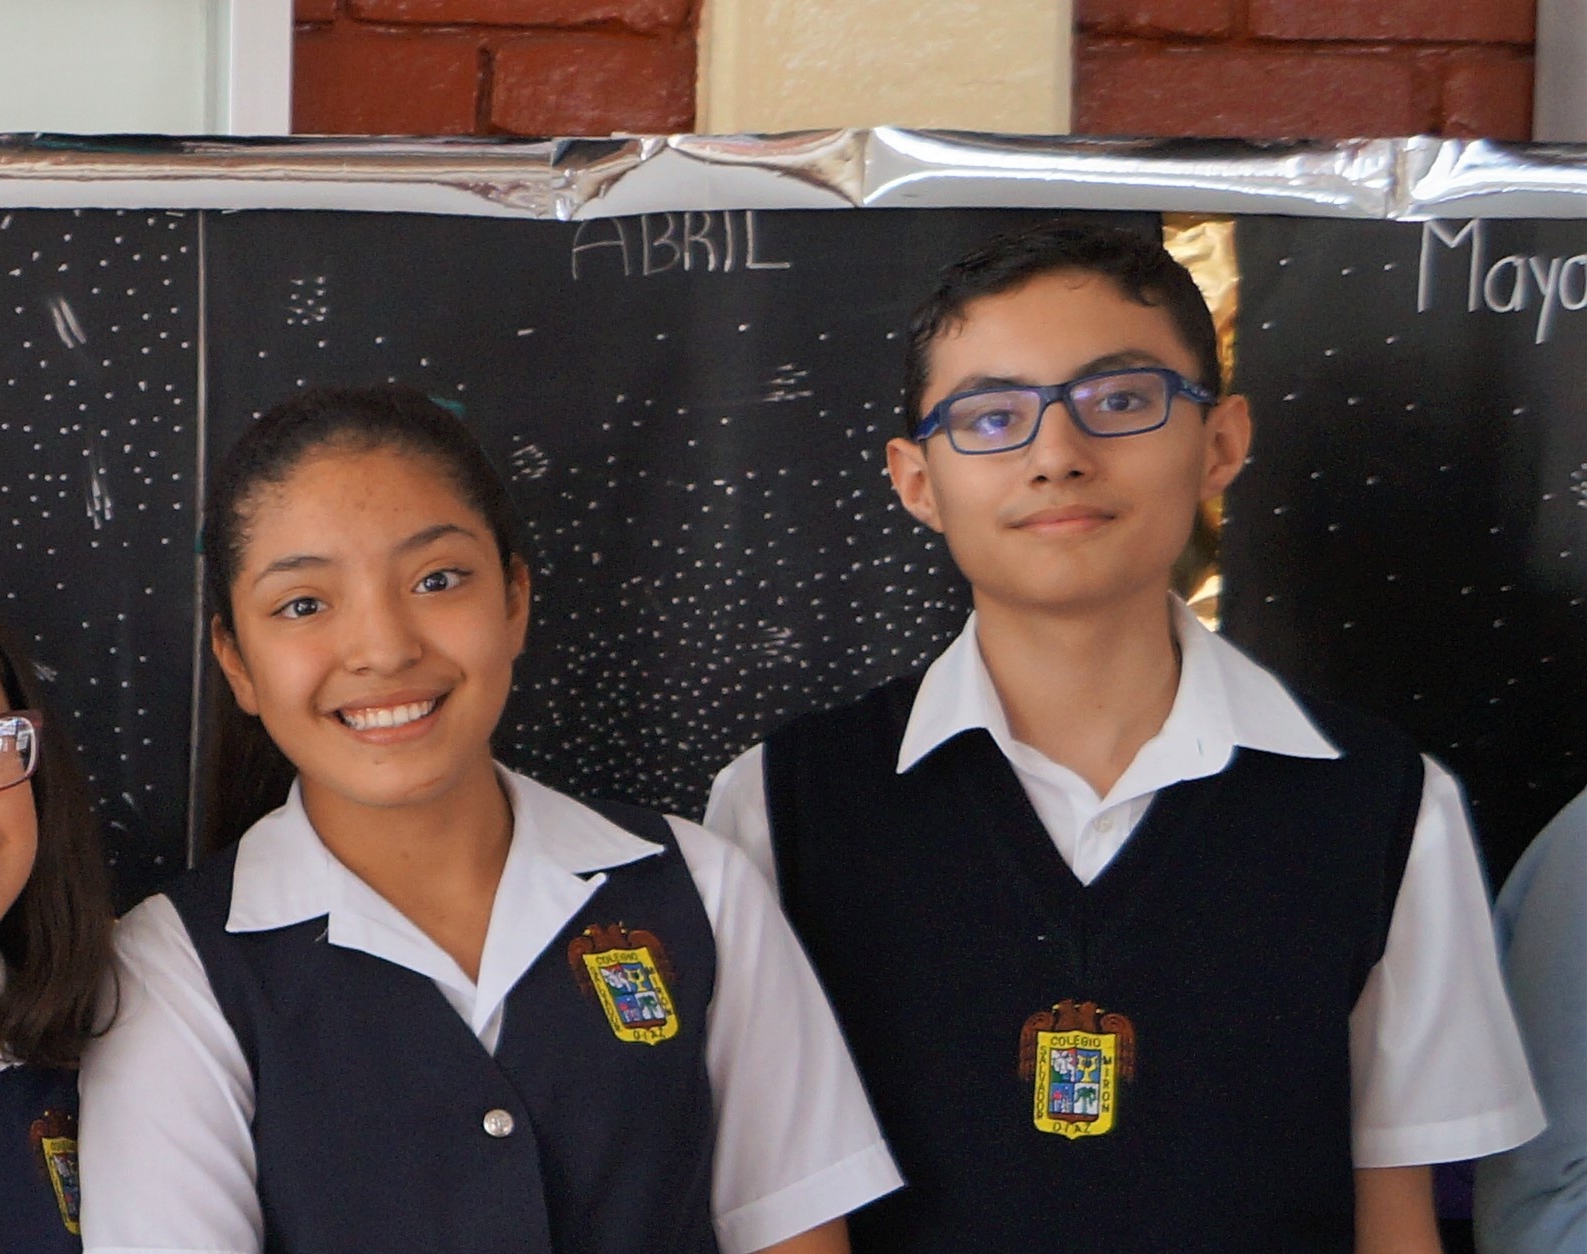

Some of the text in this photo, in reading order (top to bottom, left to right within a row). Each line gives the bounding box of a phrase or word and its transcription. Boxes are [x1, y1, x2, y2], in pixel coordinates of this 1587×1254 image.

[571, 210, 790, 280] ABRIL
[1417, 218, 1587, 345] Mayo
[1050, 1035, 1102, 1047] COLEGIO
[1052, 1121, 1091, 1134] DIAZ
